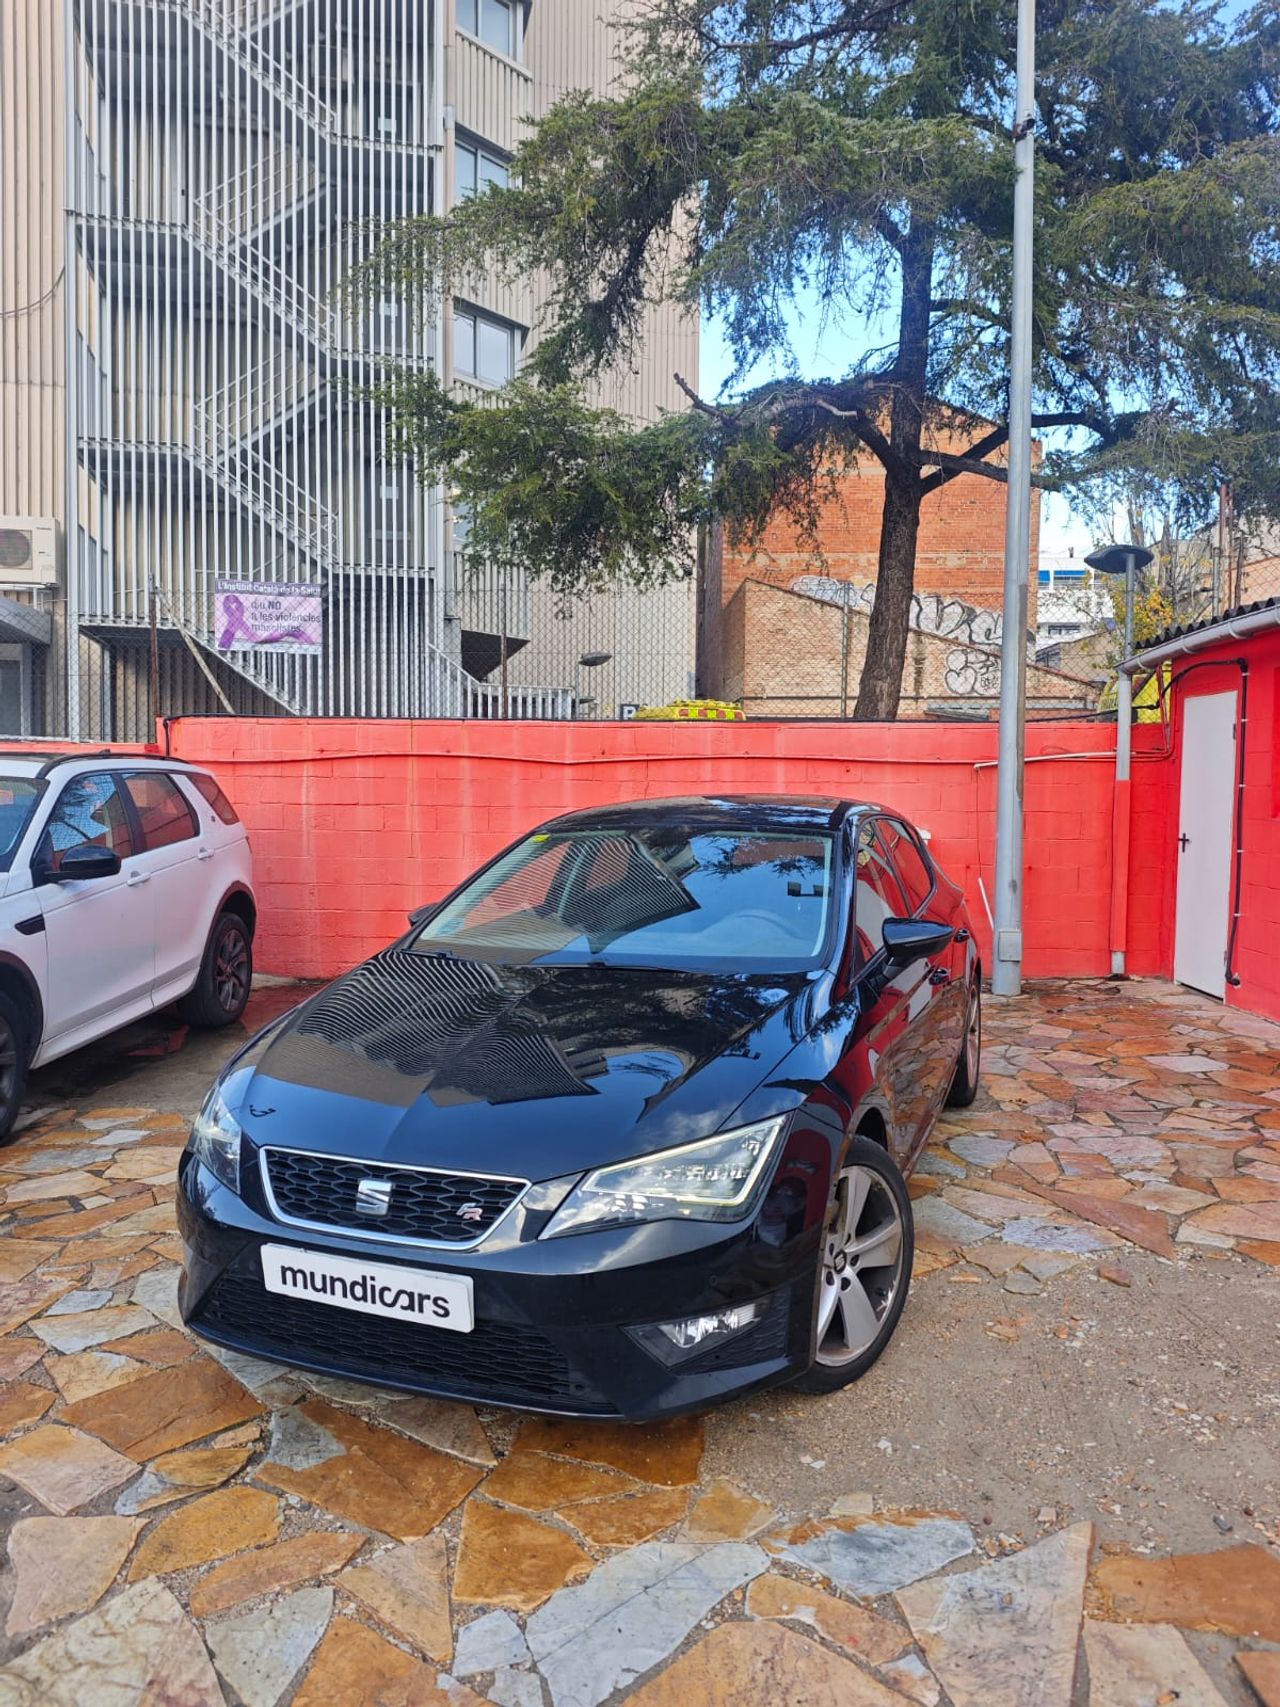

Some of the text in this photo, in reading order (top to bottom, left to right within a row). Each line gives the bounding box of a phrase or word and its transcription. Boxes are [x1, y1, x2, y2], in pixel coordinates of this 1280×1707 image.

[217, 581, 253, 591] L'Institut
[280, 586, 290, 594] de
[291, 586, 300, 594] la
[300, 586, 320, 595] Salut
[268, 601, 282, 610] NO
[260, 612, 273, 621] les
[280, 1265, 451, 1318] mundicars
